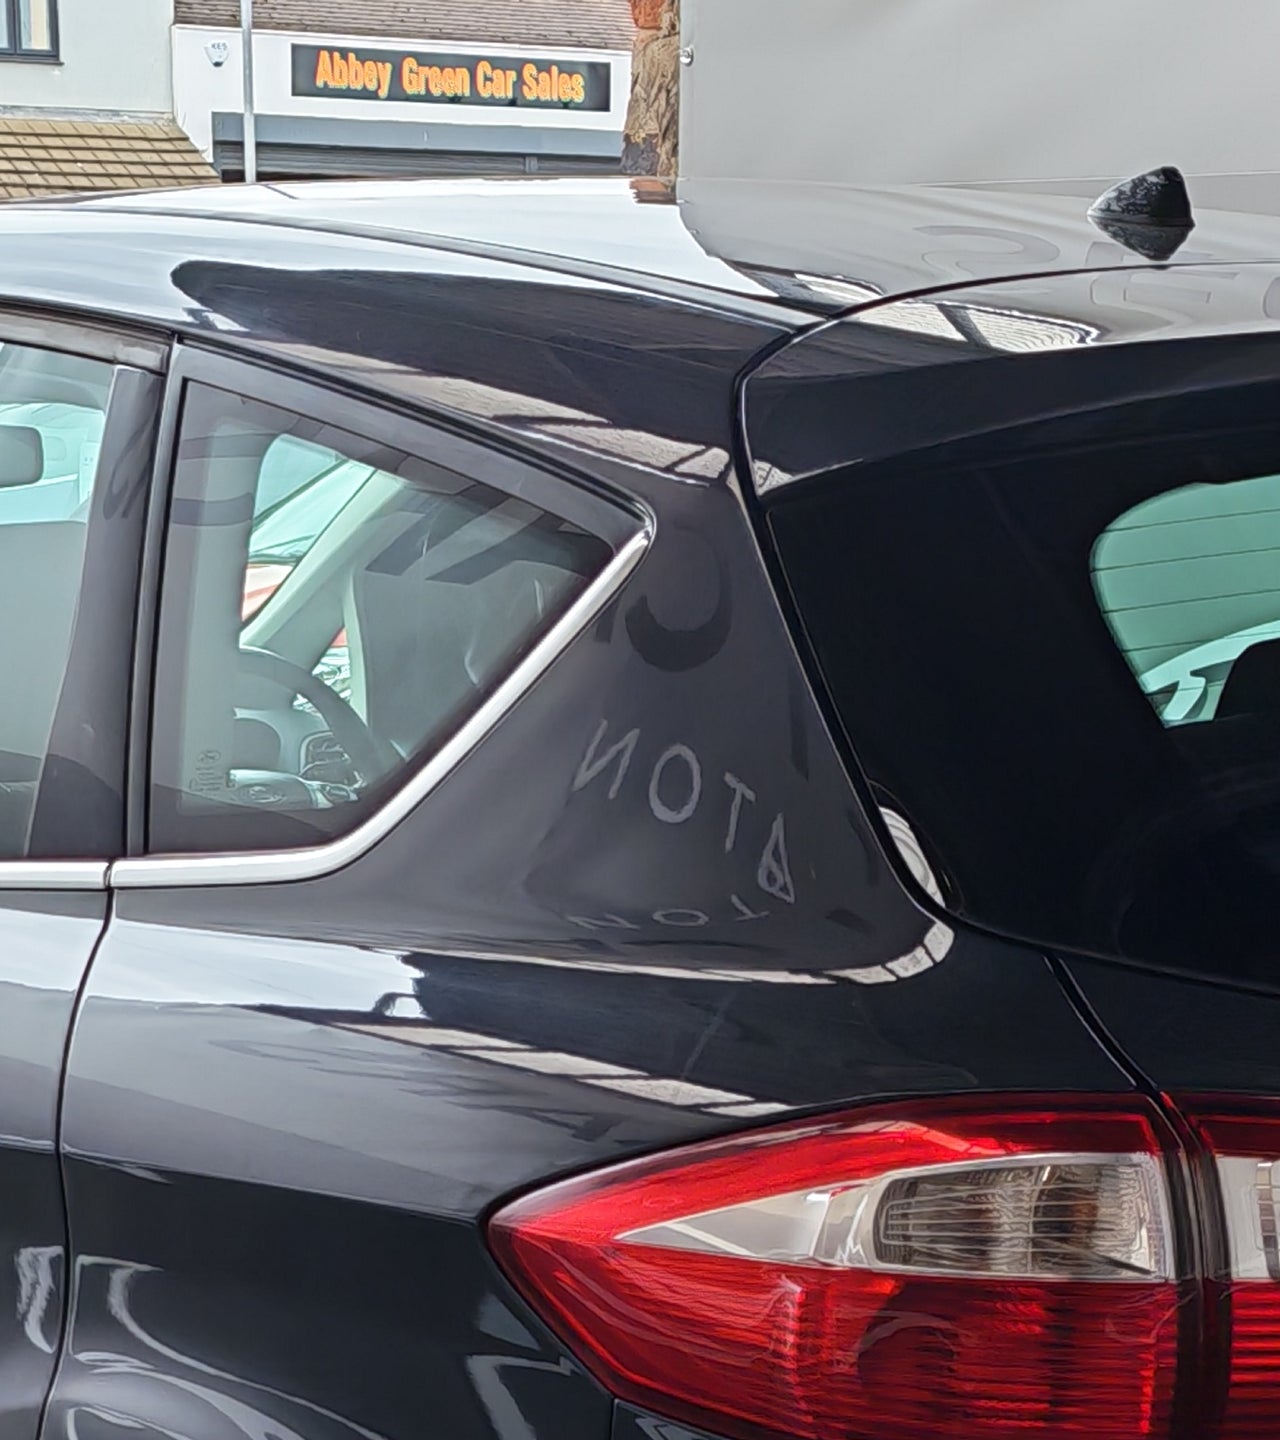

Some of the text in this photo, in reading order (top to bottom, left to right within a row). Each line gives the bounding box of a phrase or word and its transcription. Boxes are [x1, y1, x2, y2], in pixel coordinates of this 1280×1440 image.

[315, 50, 585, 103] Abbey Green Car Sales
